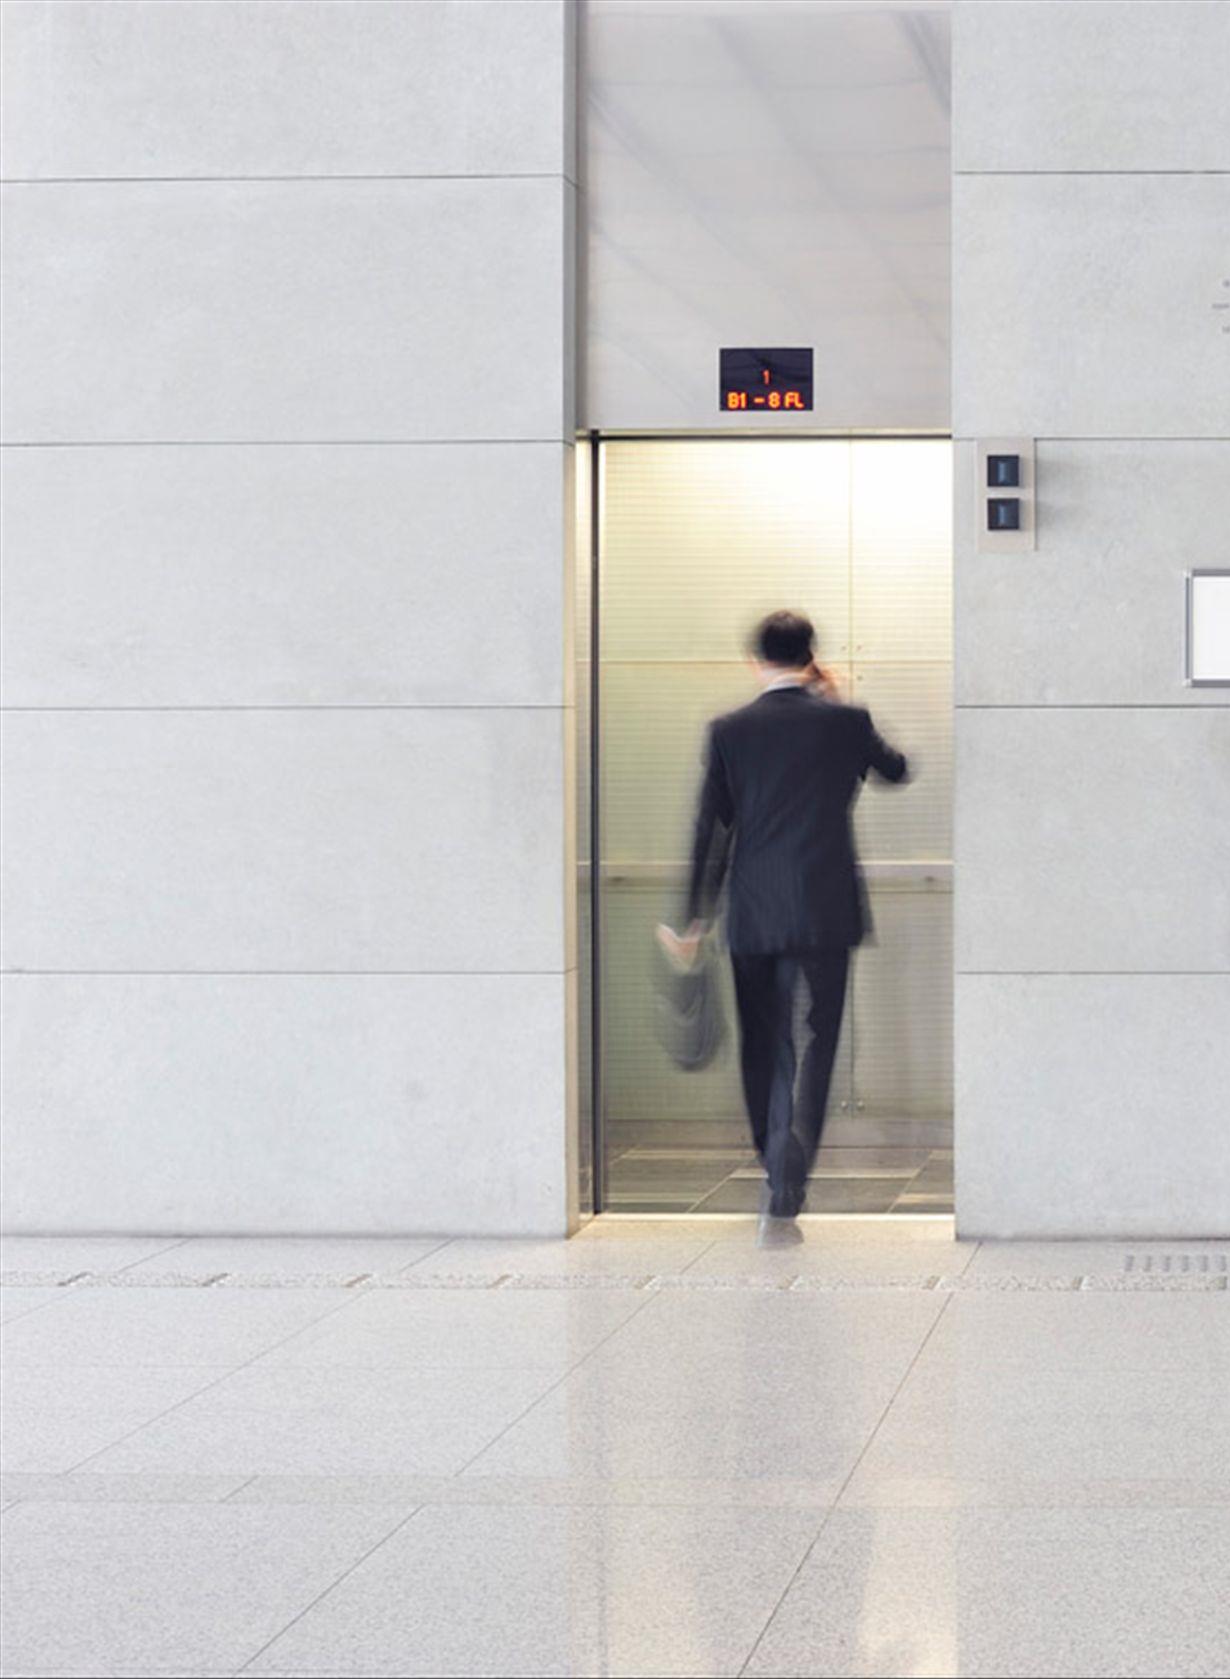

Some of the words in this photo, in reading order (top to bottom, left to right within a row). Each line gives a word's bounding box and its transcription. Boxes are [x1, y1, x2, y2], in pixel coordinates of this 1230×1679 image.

[762, 369, 770, 385] 1
[727, 391, 747, 409] B1
[768, 391, 781, 409] 8
